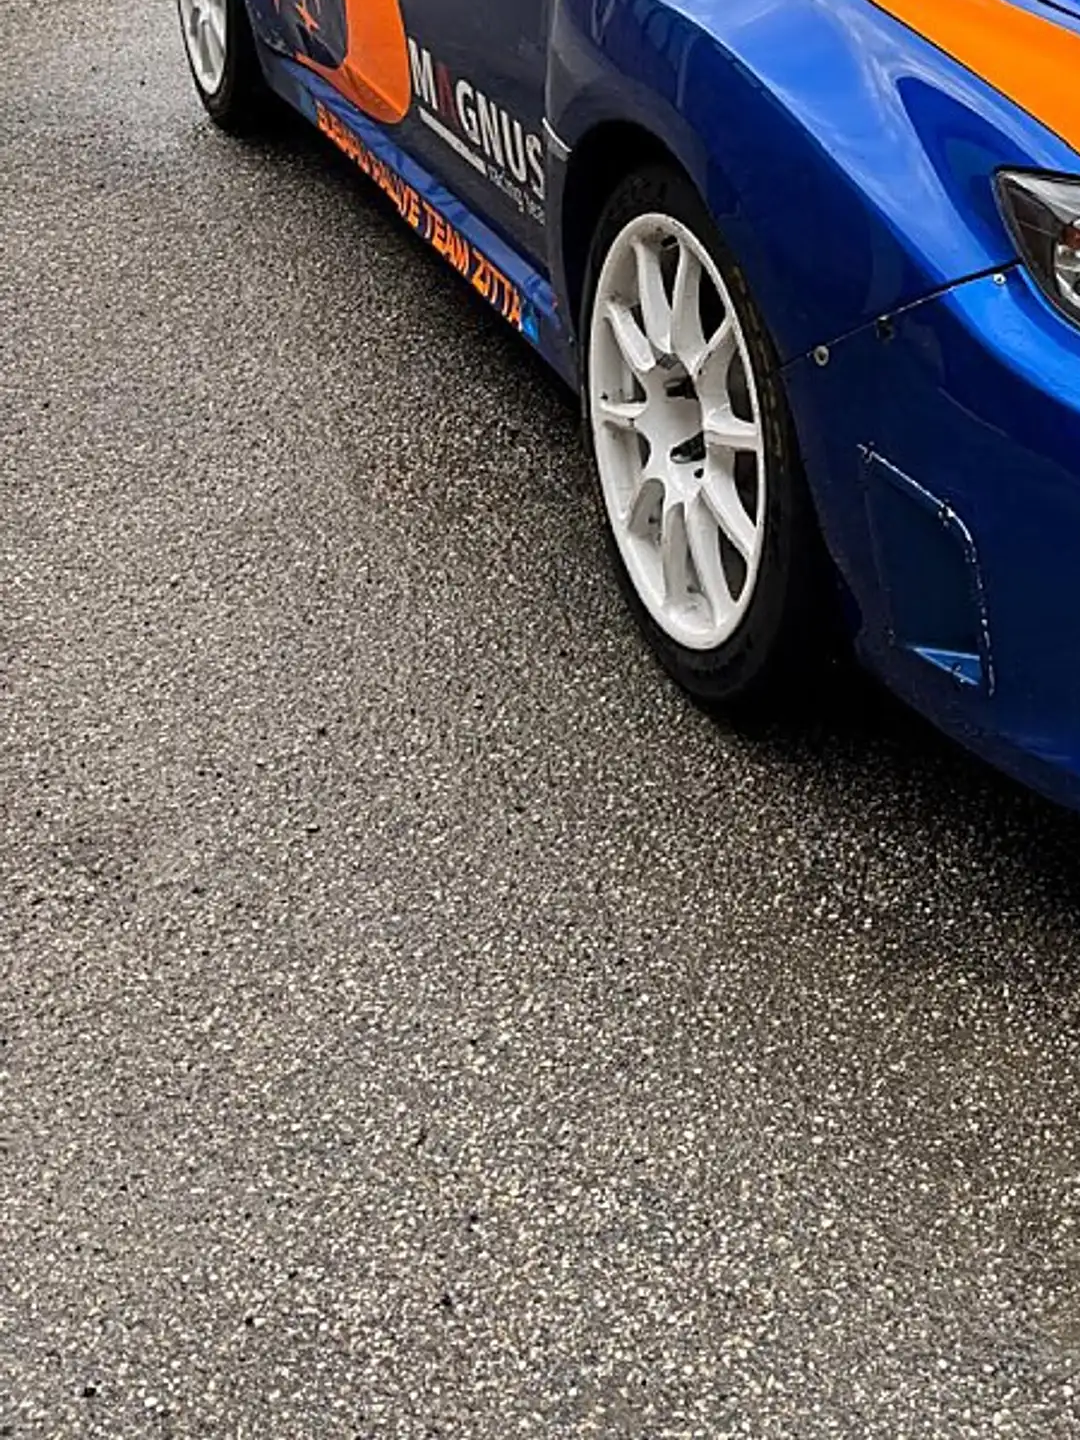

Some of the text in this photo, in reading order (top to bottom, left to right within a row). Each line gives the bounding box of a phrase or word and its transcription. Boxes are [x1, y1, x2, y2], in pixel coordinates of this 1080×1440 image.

[408, 35, 544, 200] MAGNUS
[423, 202, 469, 276] TEAM
[472, 248, 523, 333] ZITTA
